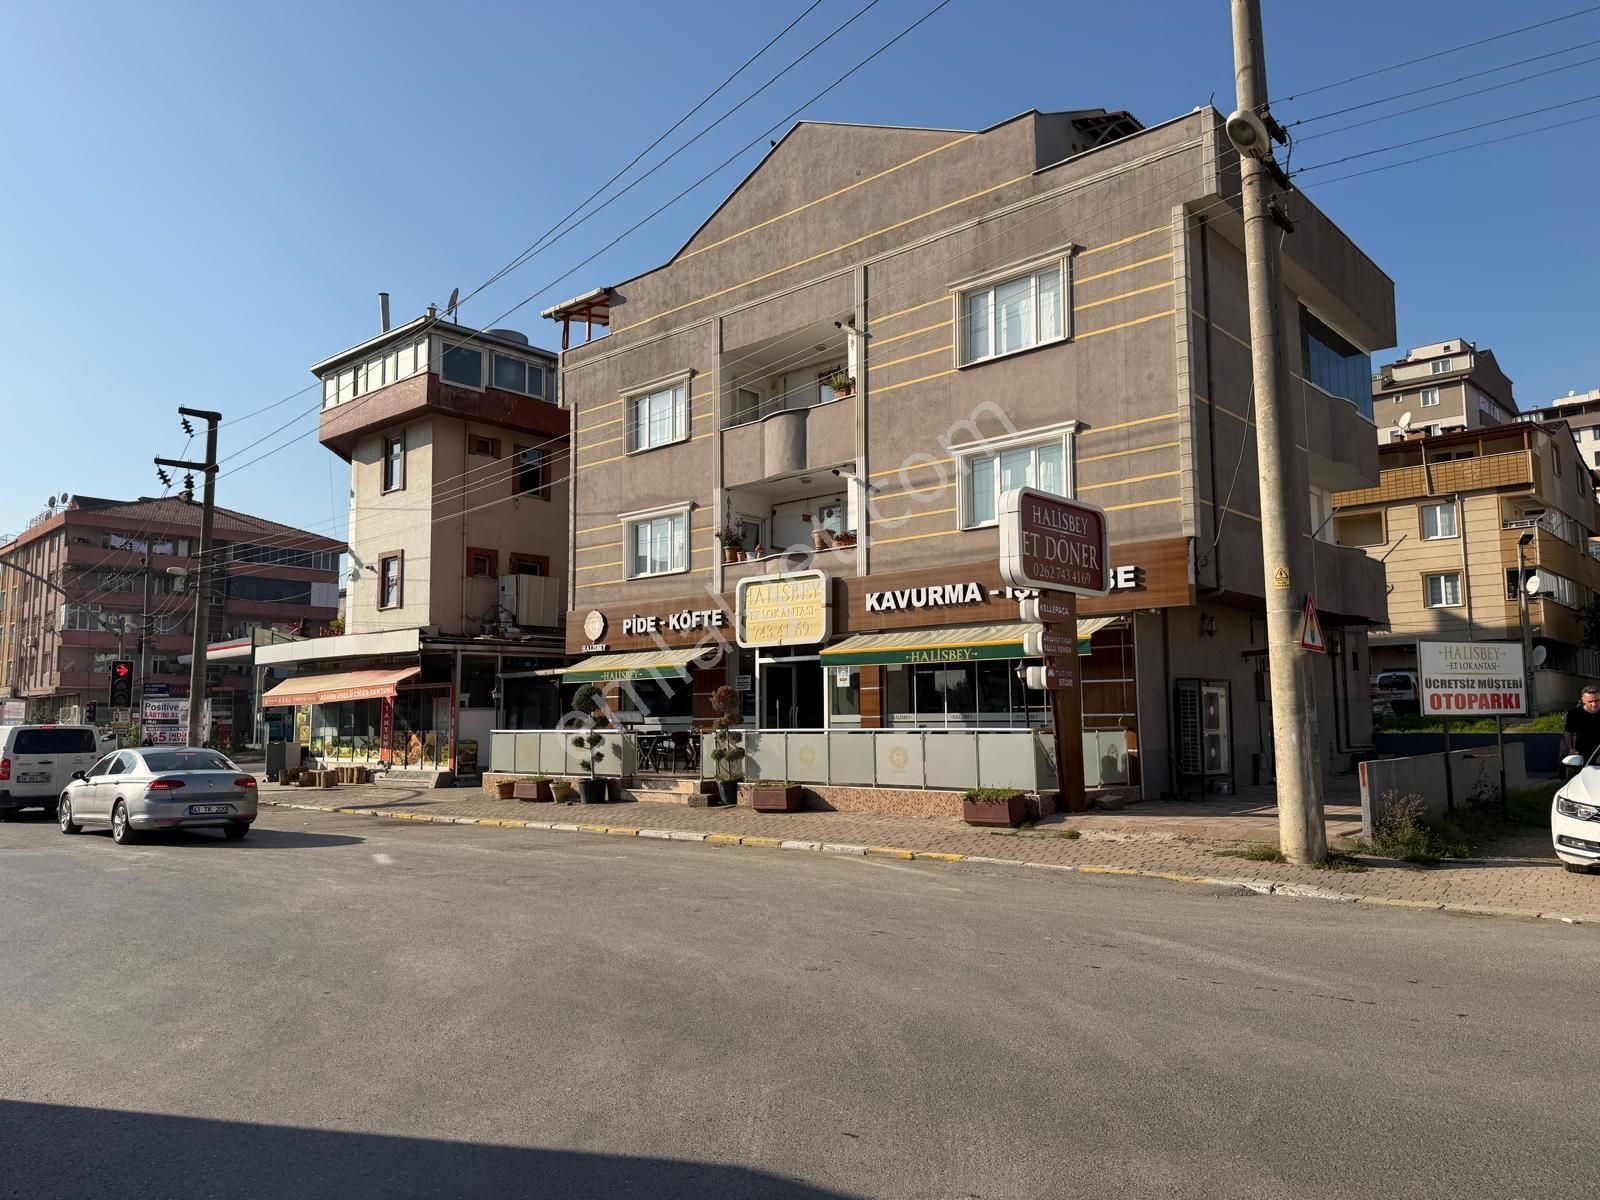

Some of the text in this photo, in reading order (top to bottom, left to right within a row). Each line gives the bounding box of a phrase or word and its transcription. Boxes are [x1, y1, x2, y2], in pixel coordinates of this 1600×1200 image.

[1032, 505, 1088, 535] HALİSBEY
[1022, 531, 1099, 570] ET DÖNER
[866, 582, 982, 611] KAVURMA
[623, 614, 656, 634] PİDE
[669, 609, 722, 629] KÖFTE
[911, 648, 972, 662] HALİSBEY
[1425, 677, 1522, 690] ÜCRETSİZ MÜŞTERİ
[145, 702, 179, 711] Positive
[1430, 693, 1520, 710] OTOPARKI
